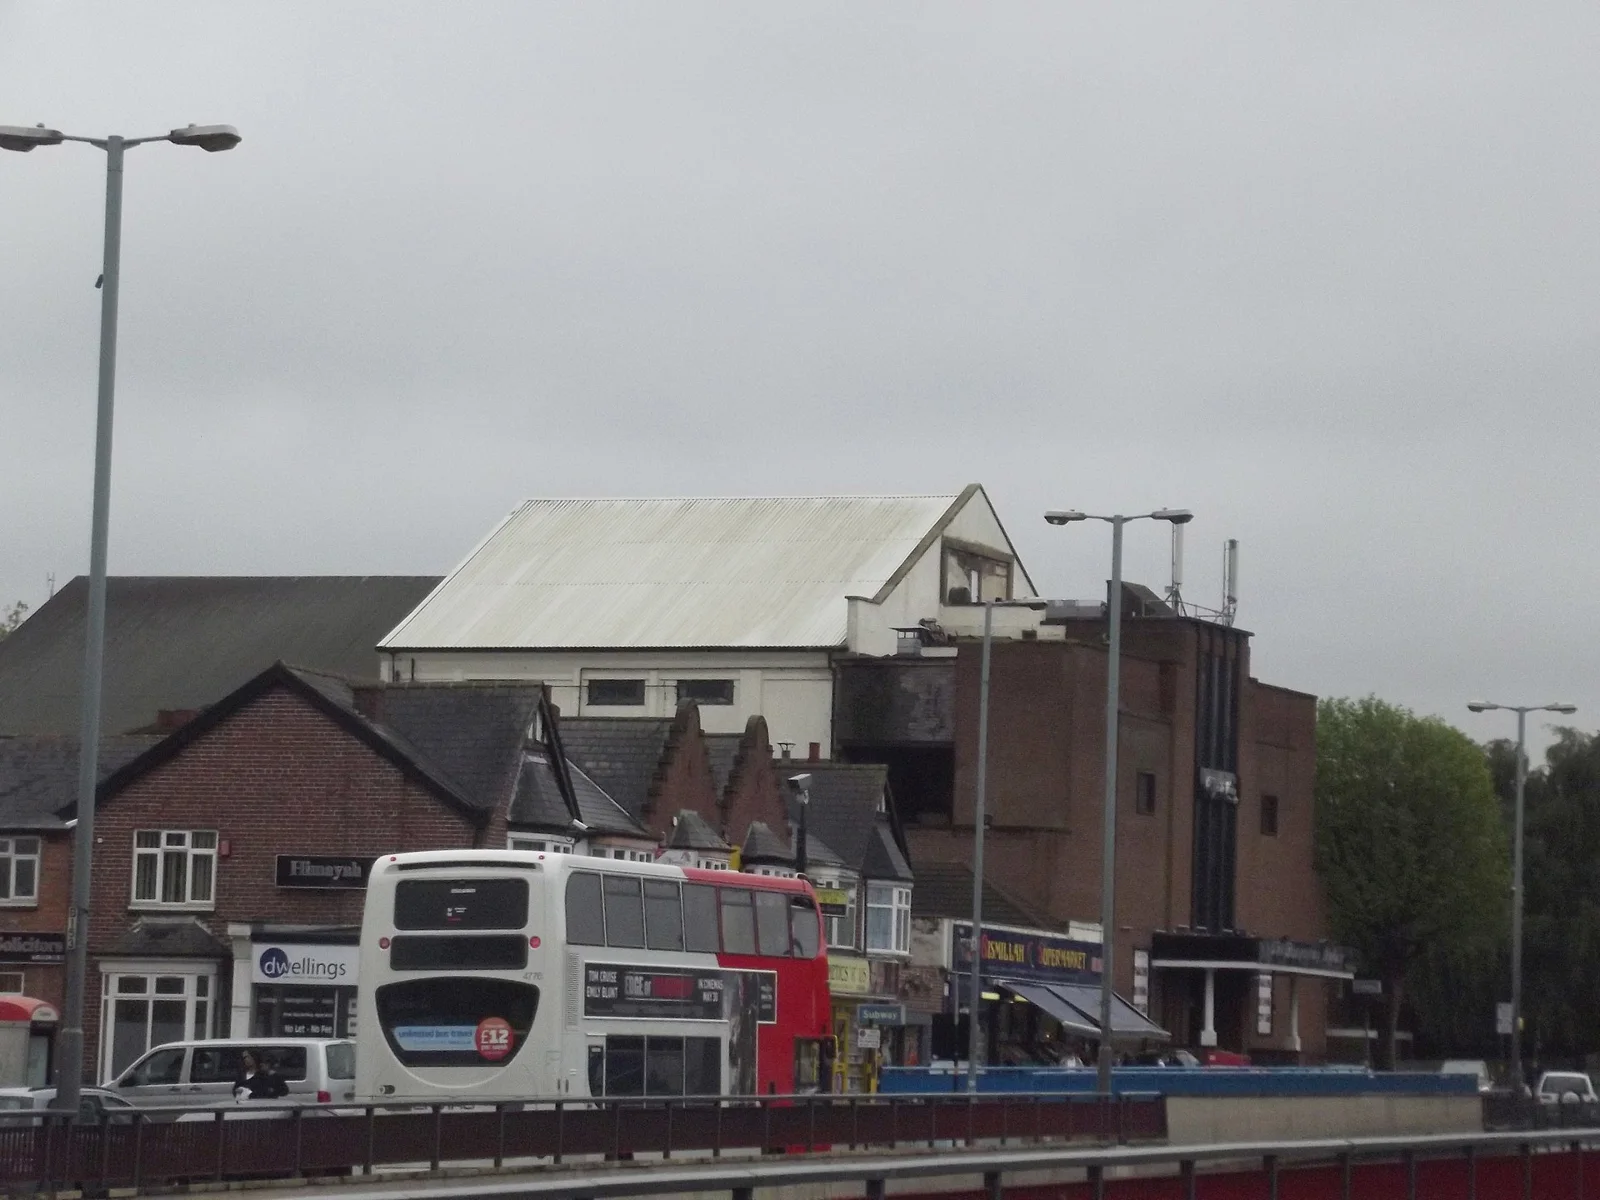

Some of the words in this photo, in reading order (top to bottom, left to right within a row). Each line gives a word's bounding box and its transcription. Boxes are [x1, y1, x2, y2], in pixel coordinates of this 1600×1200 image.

[264, 957, 346, 979] dwellings
[588, 970, 599, 982] TOM
[600, 971, 617, 983] CRUISE
[624, 975, 644, 996] EDGE
[863, 1010, 898, 1020] Subway
[480, 1029, 509, 1044] £12
